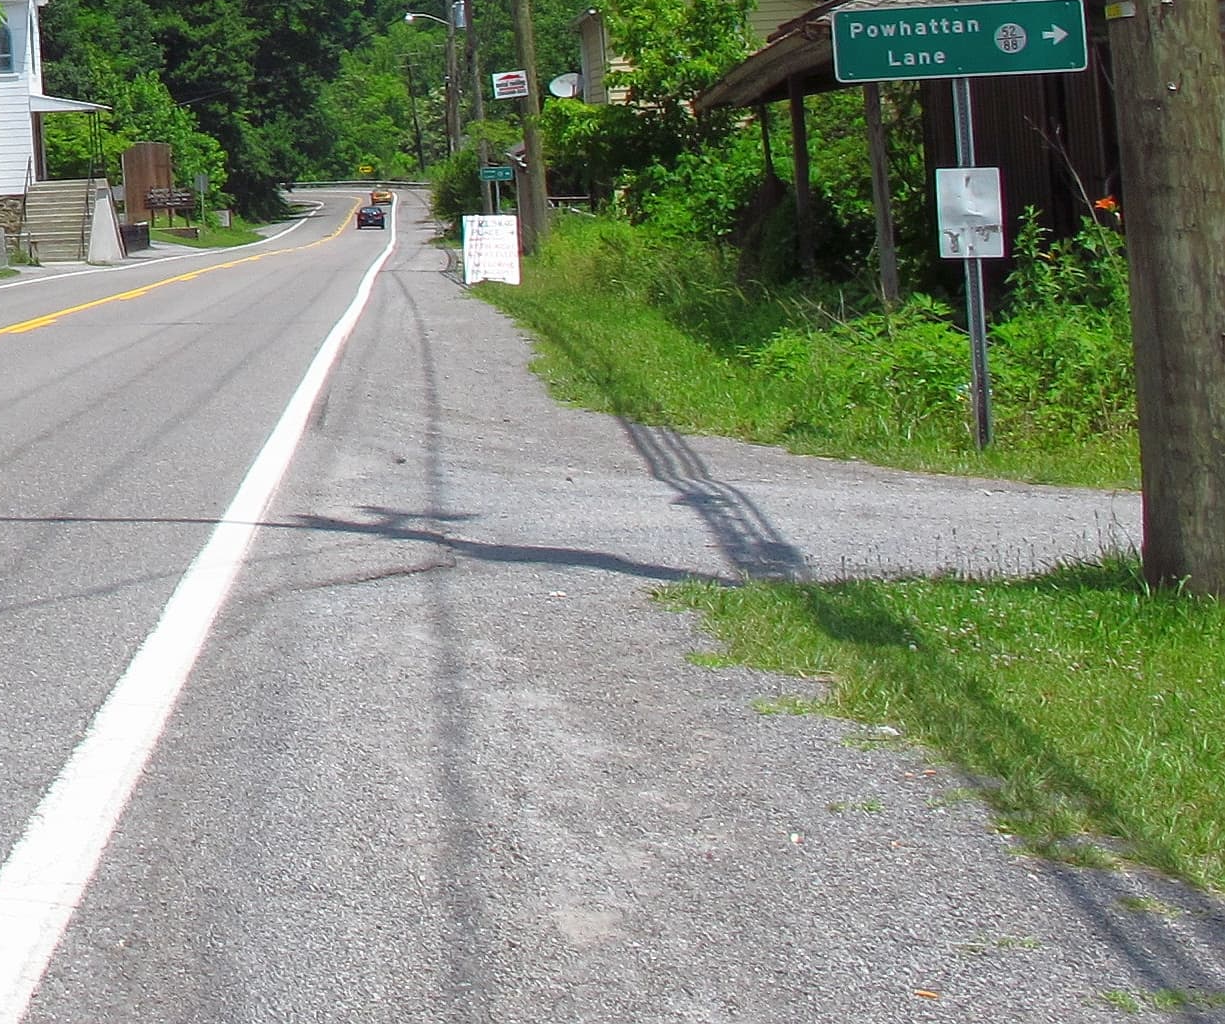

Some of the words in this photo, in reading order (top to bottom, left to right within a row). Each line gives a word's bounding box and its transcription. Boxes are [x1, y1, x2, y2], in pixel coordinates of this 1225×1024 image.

[849, 18, 980, 39] Powhattan
[1001, 25, 1017, 37] 52
[1003, 39, 1018, 51] 88
[888, 50, 946, 66] Lane
